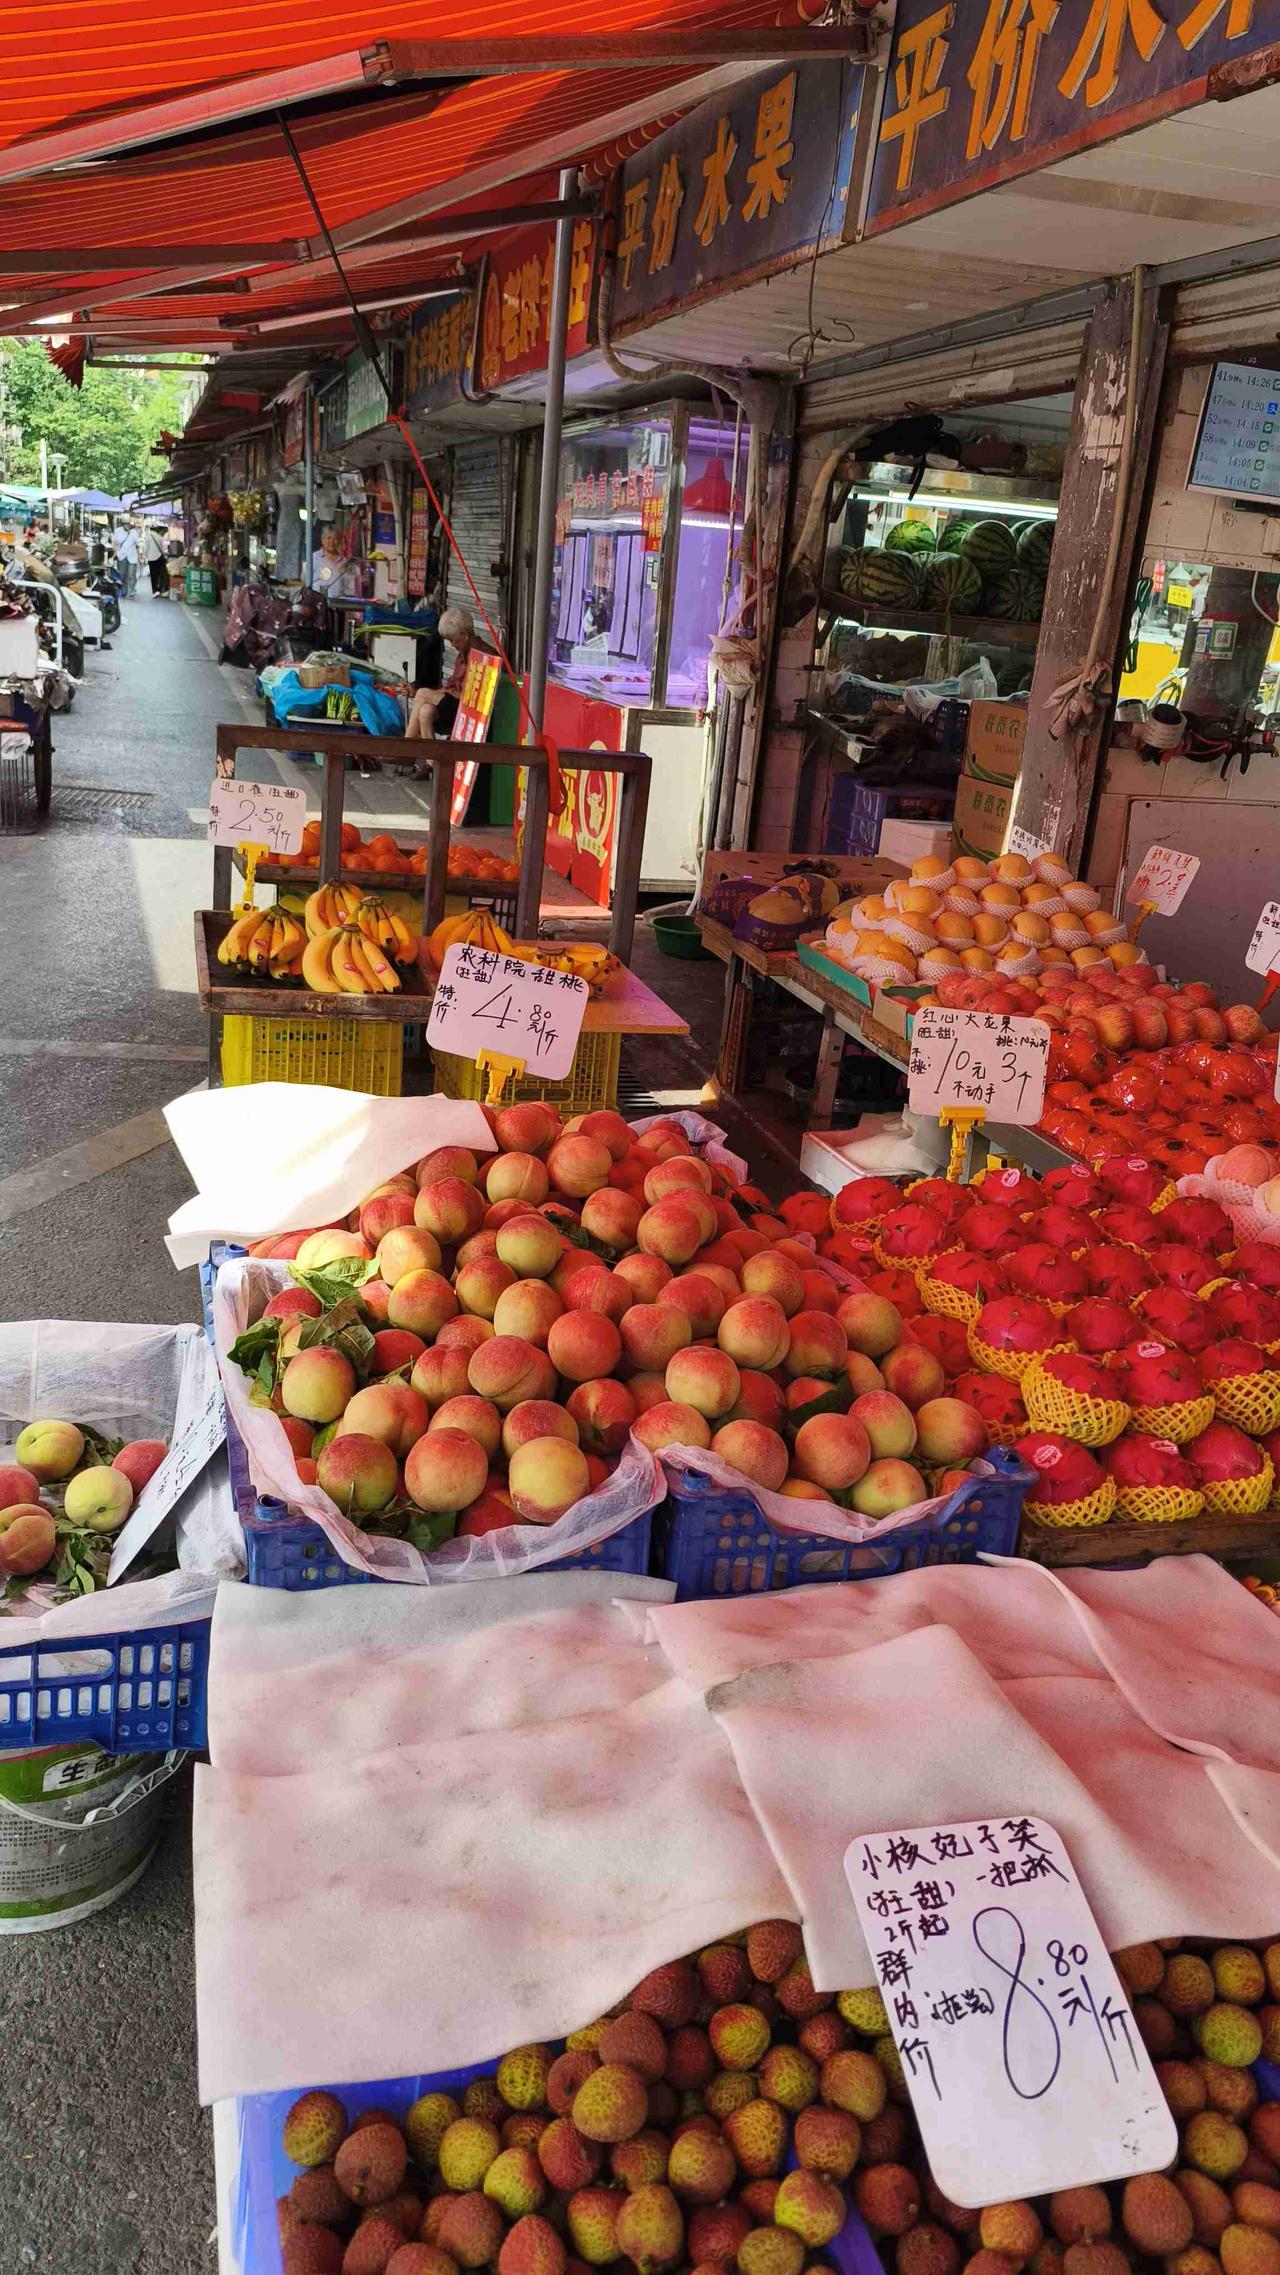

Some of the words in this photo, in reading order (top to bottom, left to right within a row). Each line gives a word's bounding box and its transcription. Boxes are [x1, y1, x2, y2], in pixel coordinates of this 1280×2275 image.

[617, 71, 798, 293] 平价水果
[1246, 375, 1271, 388] 14:26
[1240, 400, 1265, 412] 14:20
[229, 799, 284, 832] 2.50
[458, 945, 585, 993] 农科院甜桃
[435, 984, 457, 1024] 特价:
[471, 984, 552, 1029] 4.80
[923, 1008, 1015, 1034] 红心火龙果
[952, 1080, 996, 1105] 不动手
[862, 1818, 1053, 1880] 小核妃子笑
[884, 1913, 950, 1955] 2斤起
[973, 1906, 1088, 2099] 8.80
